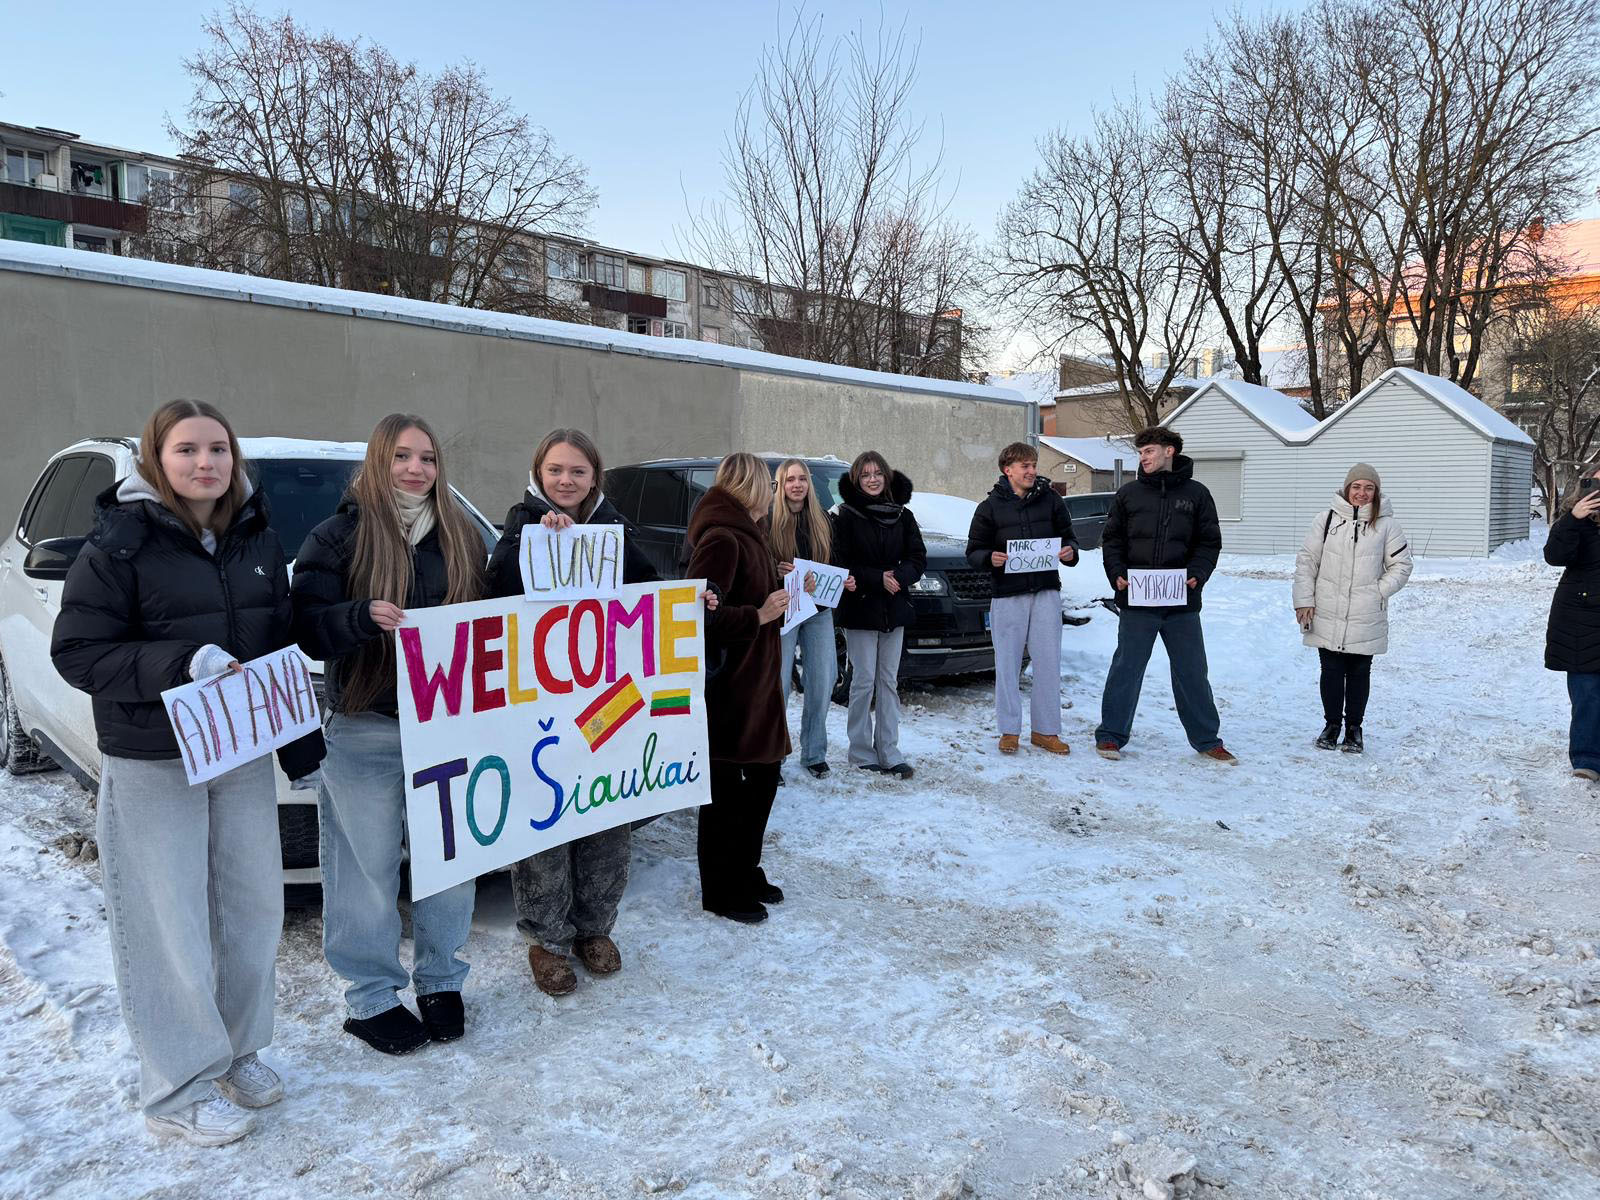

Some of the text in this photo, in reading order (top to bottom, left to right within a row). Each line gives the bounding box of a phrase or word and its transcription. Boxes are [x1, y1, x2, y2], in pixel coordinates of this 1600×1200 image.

[1009, 540, 1037, 553] MARC
[171, 651, 315, 776] AITANA
[400, 586, 699, 723] WELCOME
[412, 717, 700, 861] TO Šiauliai
